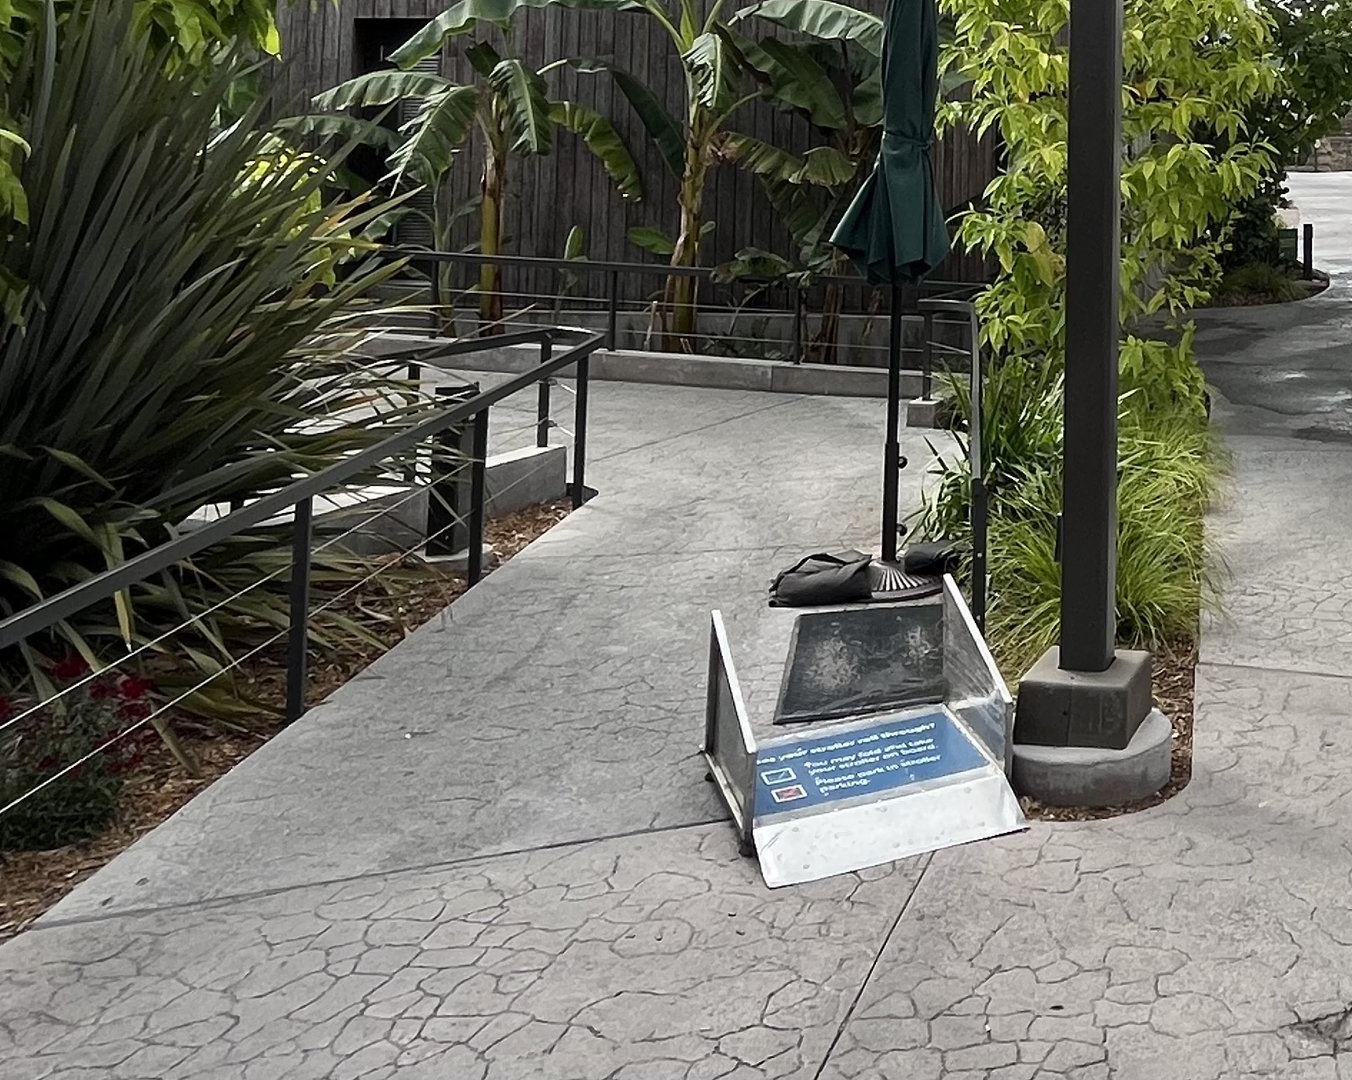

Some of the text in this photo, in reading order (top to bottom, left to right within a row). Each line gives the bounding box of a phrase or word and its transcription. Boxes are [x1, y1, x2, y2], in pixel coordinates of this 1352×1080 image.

[804, 760, 828, 769] You
[830, 753, 856, 764] may
[857, 747, 881, 758] fold
[908, 737, 934, 747] take
[809, 740, 855, 754] stroller
[808, 765, 837, 776] your
[838, 755, 880, 768] stroller
[882, 751, 900, 760] on
[857, 767, 885, 778] park
[886, 763, 899, 771] in
[900, 754, 941, 767] stroller
